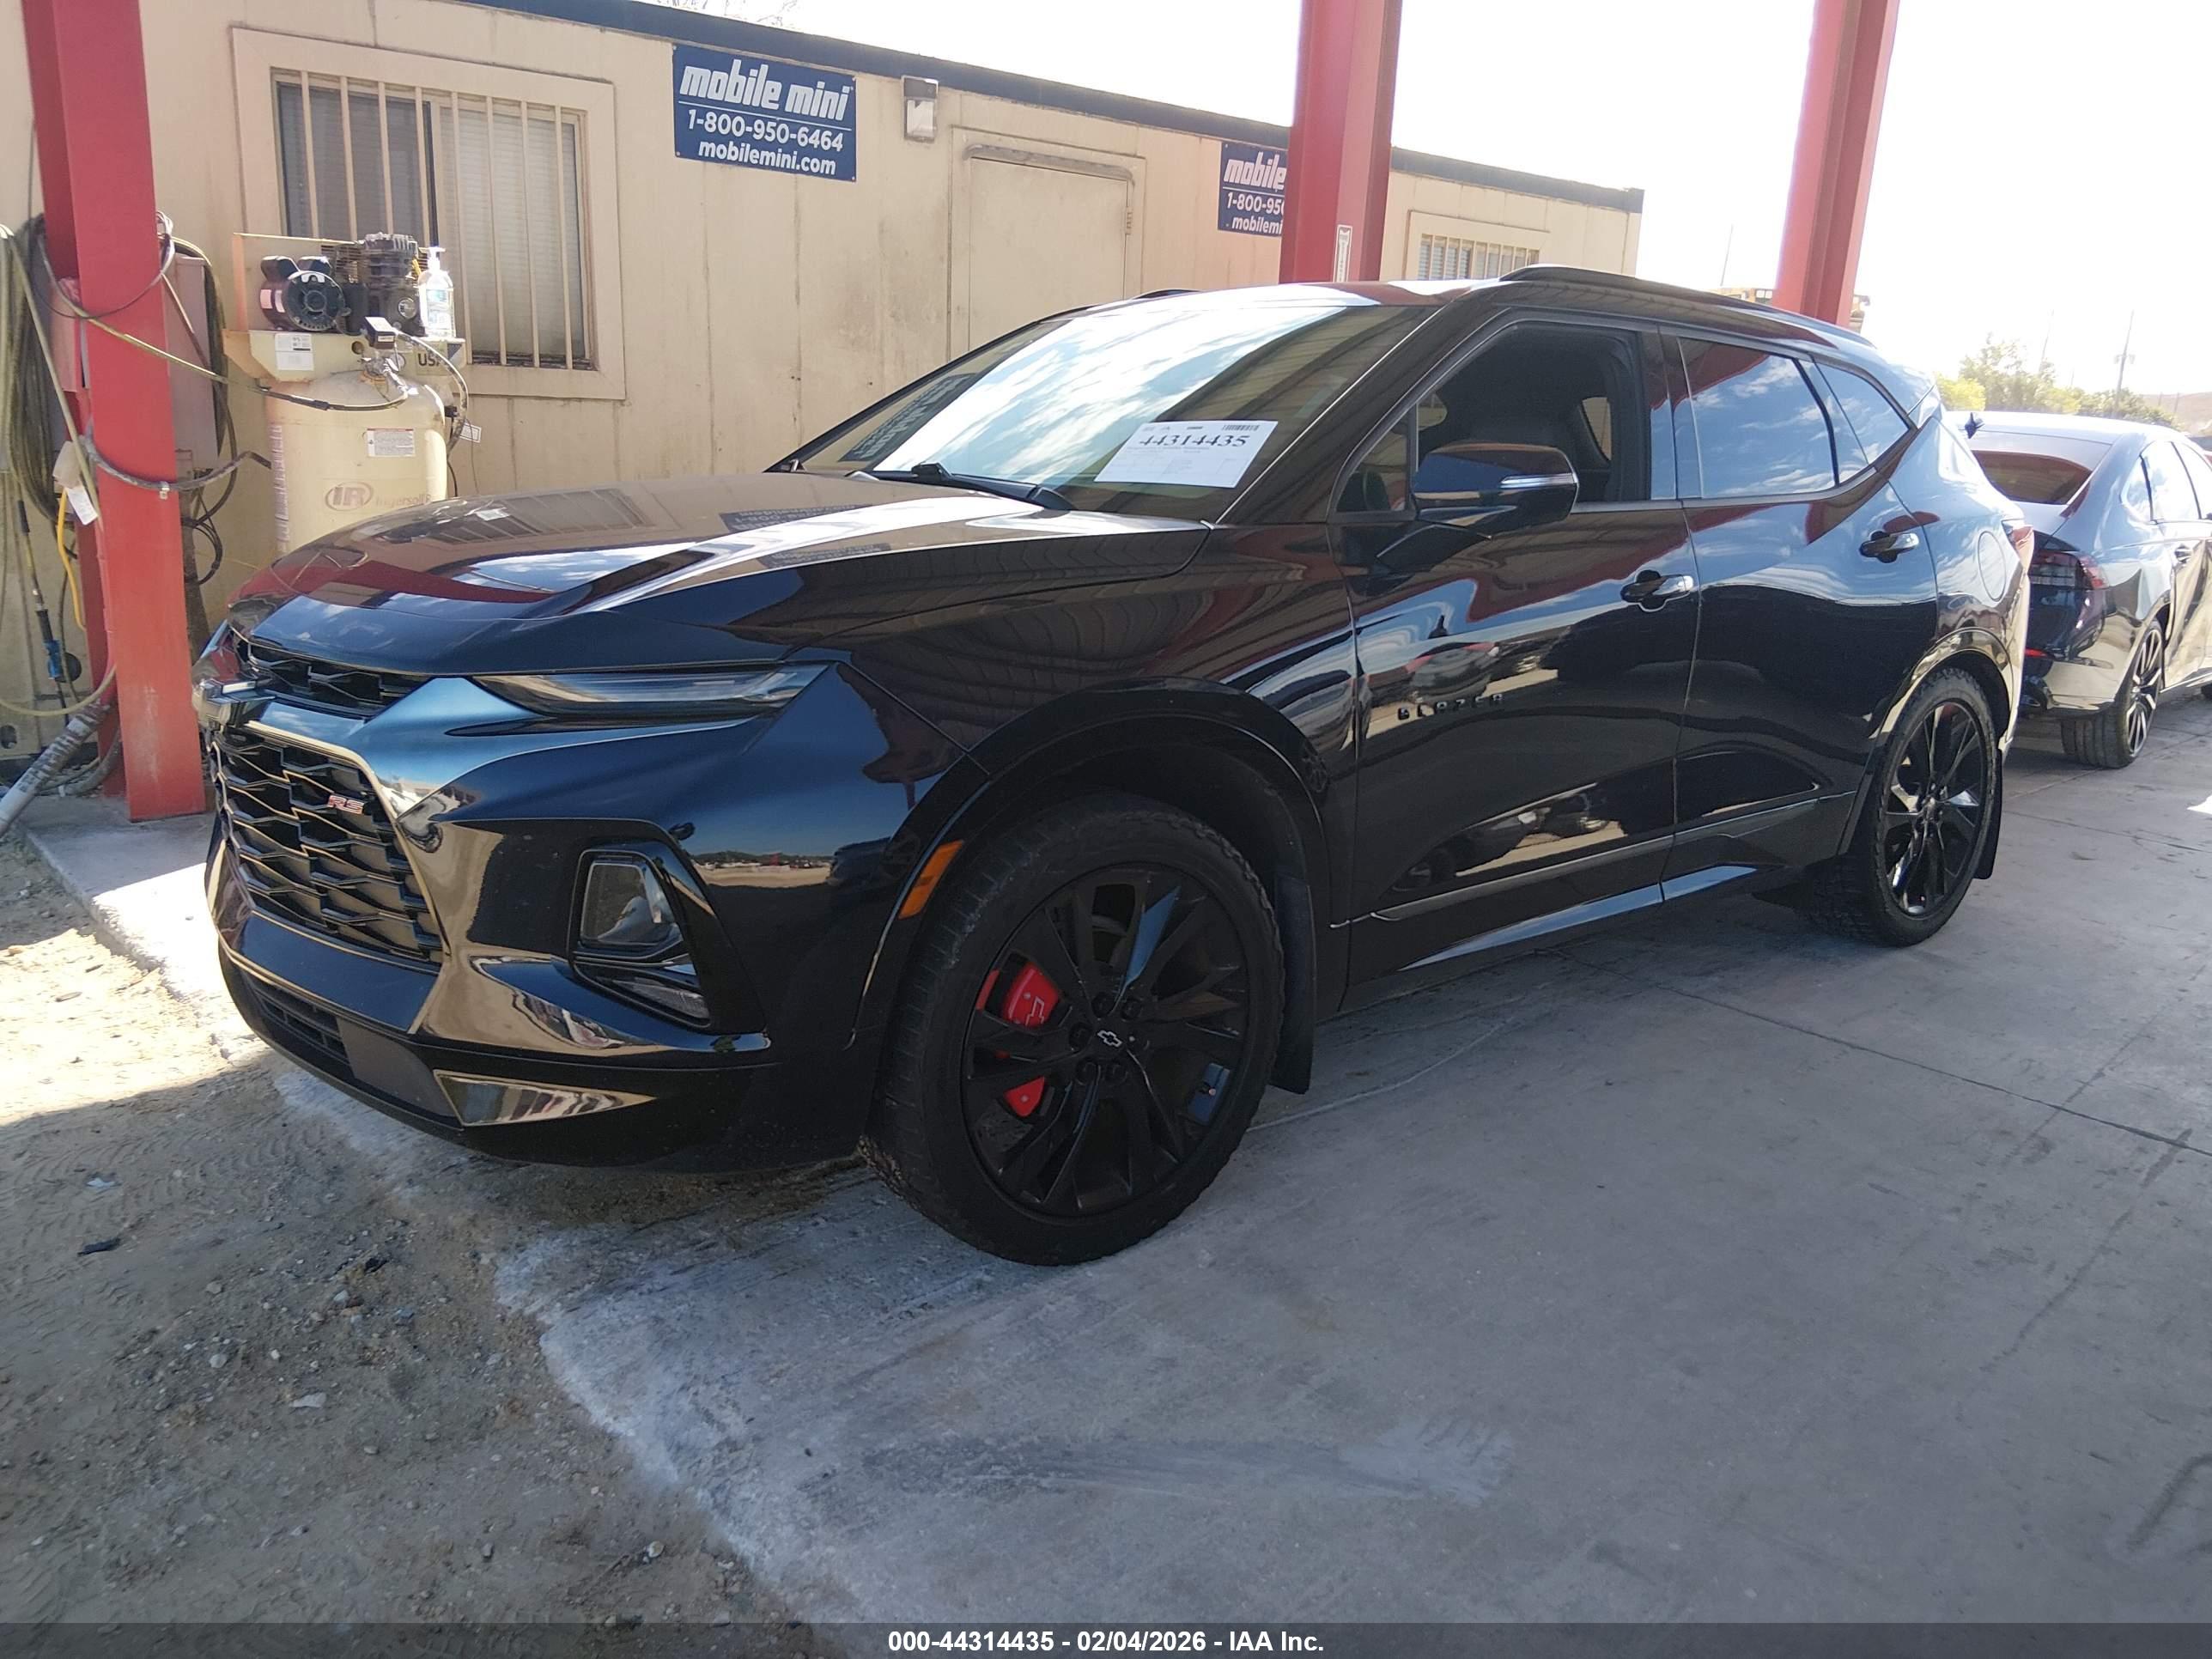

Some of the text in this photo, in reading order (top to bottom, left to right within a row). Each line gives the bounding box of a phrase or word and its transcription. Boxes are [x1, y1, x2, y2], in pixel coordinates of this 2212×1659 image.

[679, 58, 851, 120] mobile mini
[688, 108, 843, 152] 1-800-950-6464
[698, 141, 836, 175] mobilemini.com
[1224, 151, 1286, 190] mobile
[1139, 434, 1250, 447] 44314435
[328, 795, 365, 815] RS
